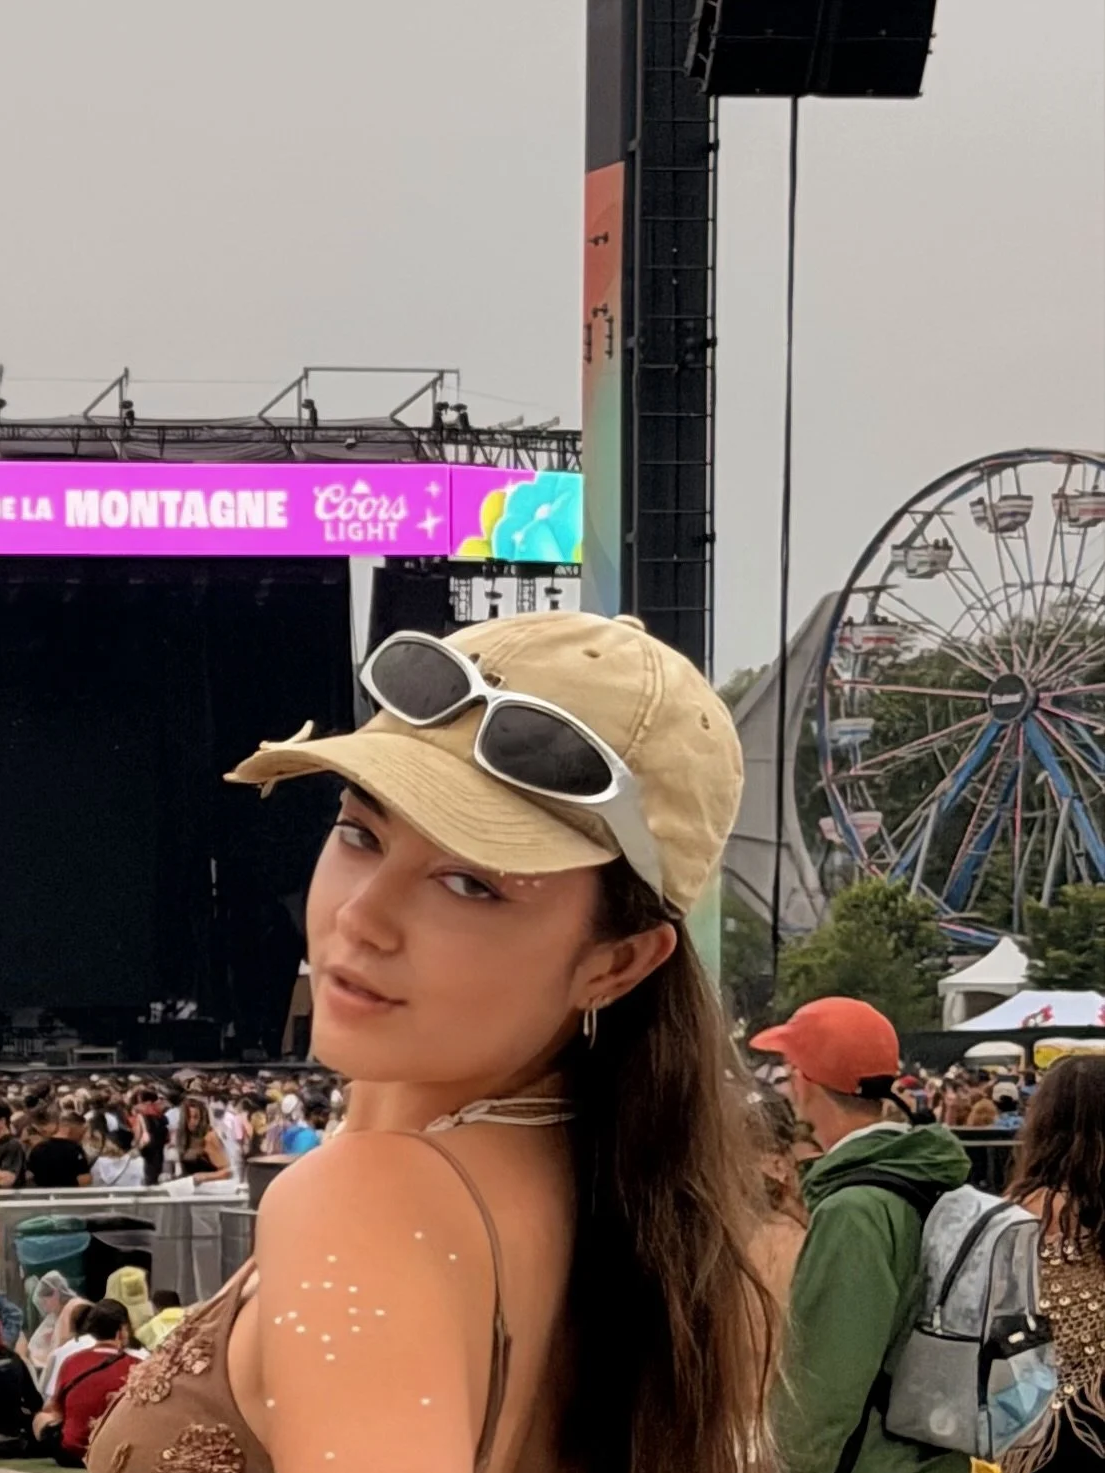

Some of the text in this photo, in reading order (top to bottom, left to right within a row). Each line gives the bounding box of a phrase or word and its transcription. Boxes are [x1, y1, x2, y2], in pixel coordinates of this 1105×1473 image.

[21, 497, 54, 522] LA
[64, 490, 289, 530] MONTAGNE
[312, 483, 409, 522] Coors
[323, 521, 400, 542] LIGHT
